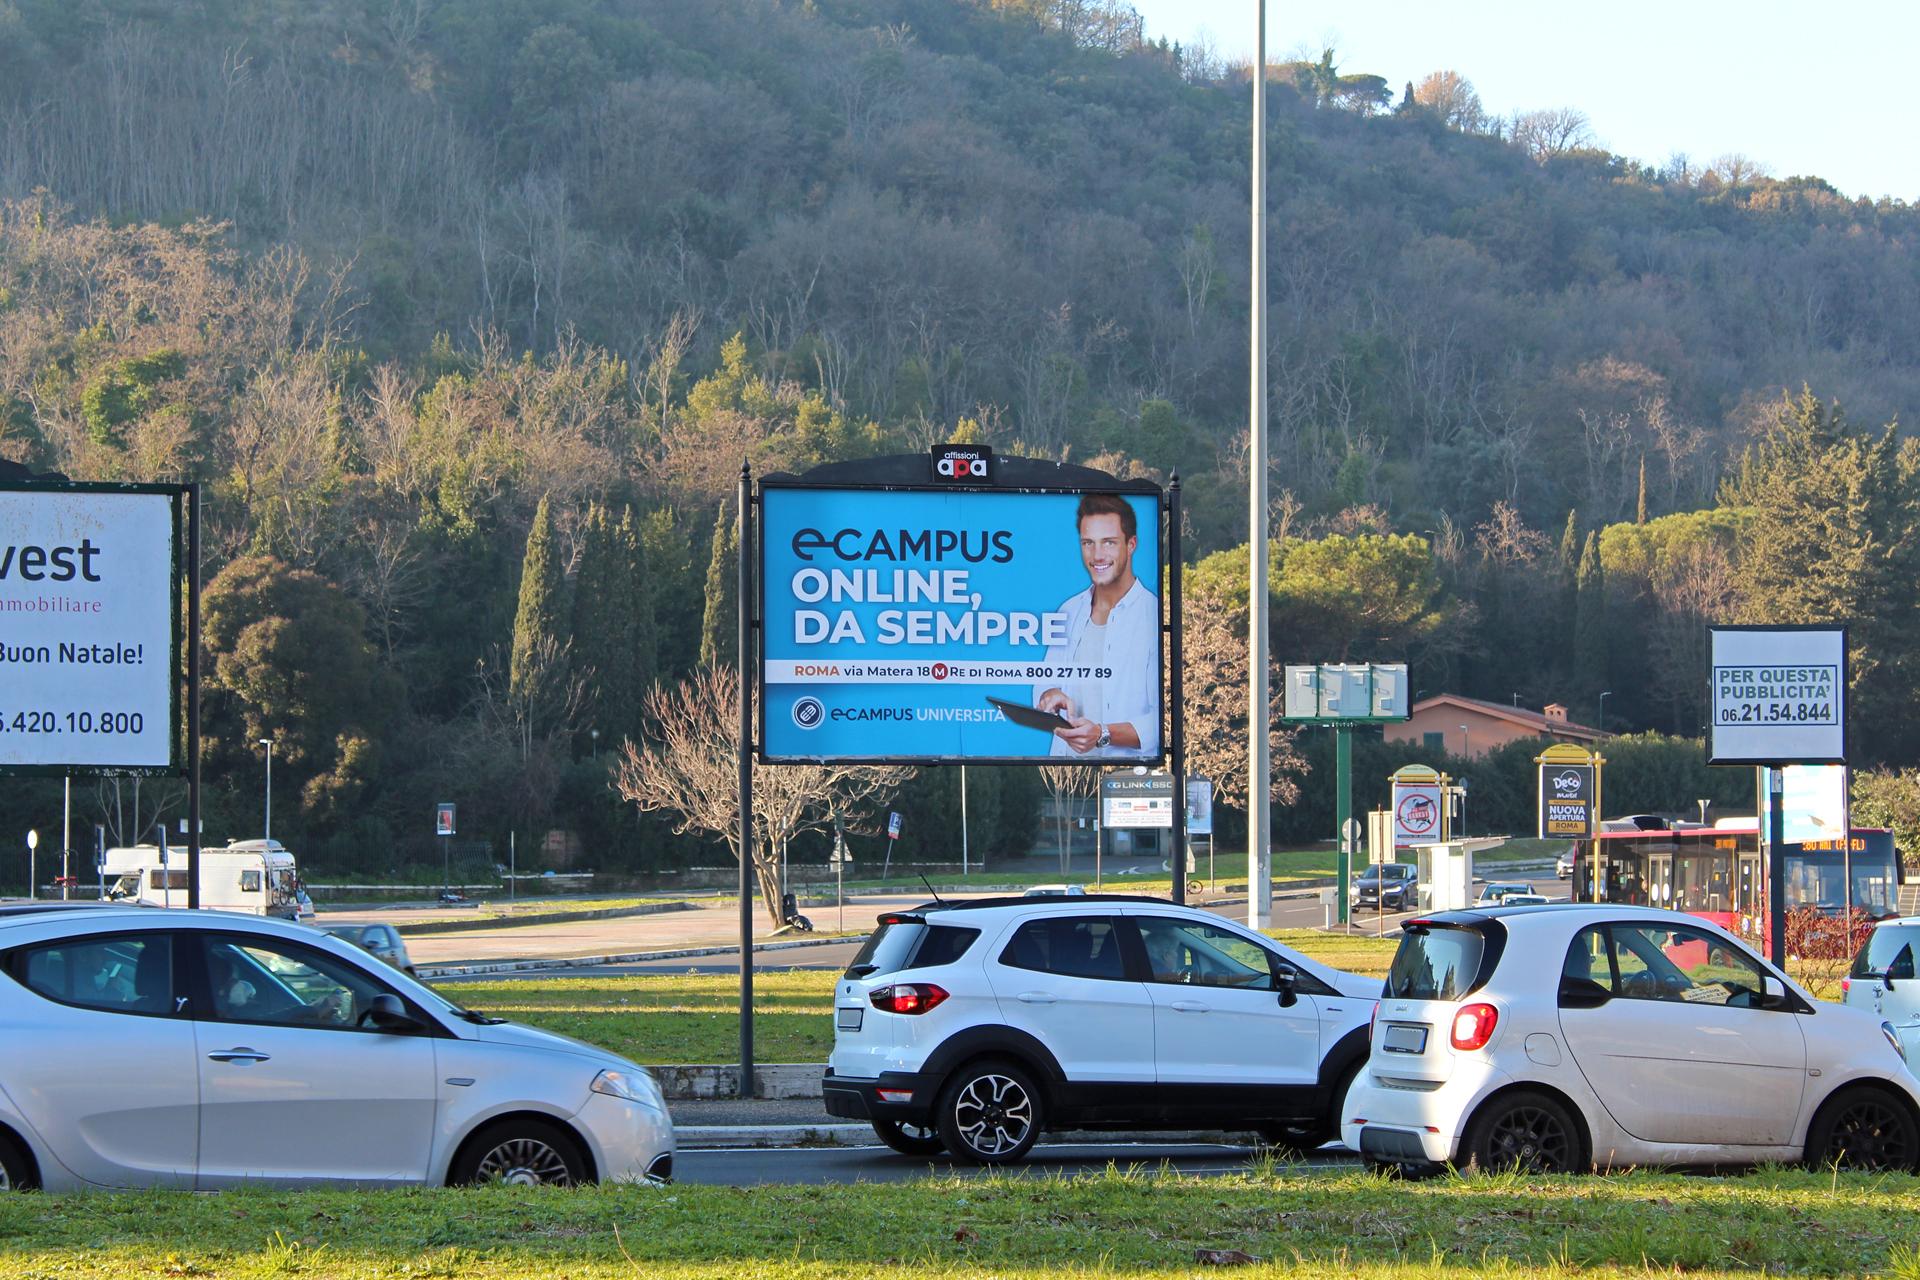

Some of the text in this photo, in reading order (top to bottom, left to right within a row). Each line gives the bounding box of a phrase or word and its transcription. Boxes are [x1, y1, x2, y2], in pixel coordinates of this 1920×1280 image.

[937, 459, 986, 479] apa
[791, 567, 982, 611] ONLINE,
[0, 597, 102, 613] mobiliare
[794, 609, 1069, 646] DA SEMPRE
[59, 642, 143, 665] Natale!
[794, 665, 840, 676] ROMA
[844, 665, 863, 677] via
[867, 665, 913, 678] Matera
[916, 665, 931, 677] 18
[1026, 667, 1053, 678] 800
[1057, 667, 1074, 678] 27
[1077, 668, 1090, 678] 17
[1095, 668, 1113, 679] 89
[1719, 669, 1831, 683] PER QUESTA
[1721, 703, 1831, 722] 06.21.54.844
[0, 711, 144, 734] .420.10.800
[1549, 806, 1585, 815] NUOVA
